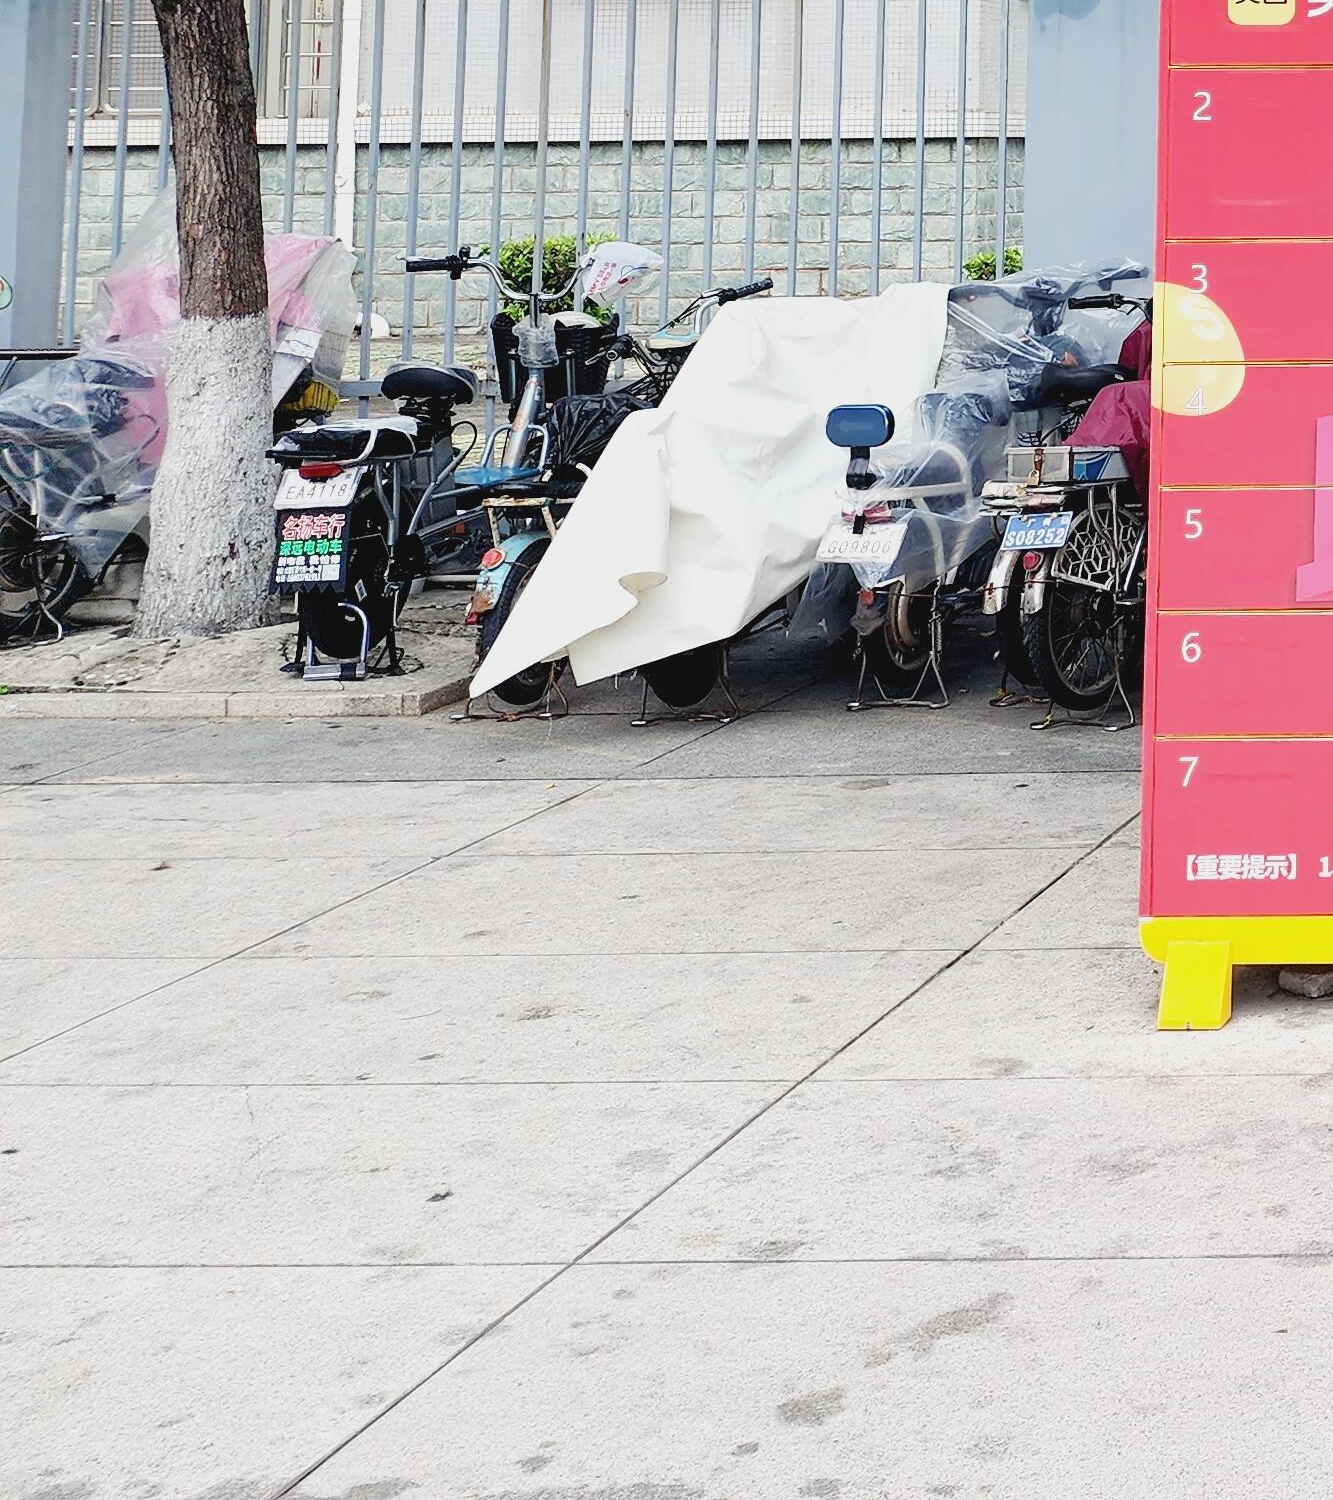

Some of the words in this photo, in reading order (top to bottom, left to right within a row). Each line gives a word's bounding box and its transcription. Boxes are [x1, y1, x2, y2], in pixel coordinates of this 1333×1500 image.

[1192, 91, 1213, 121] 2
[1190, 264, 1209, 294] 3
[1185, 386, 1207, 415] 4
[1005, 527, 1066, 547] S08252
[1184, 509, 1203, 539] 5
[1181, 633, 1202, 662] 6
[1178, 757, 1199, 787] 7
